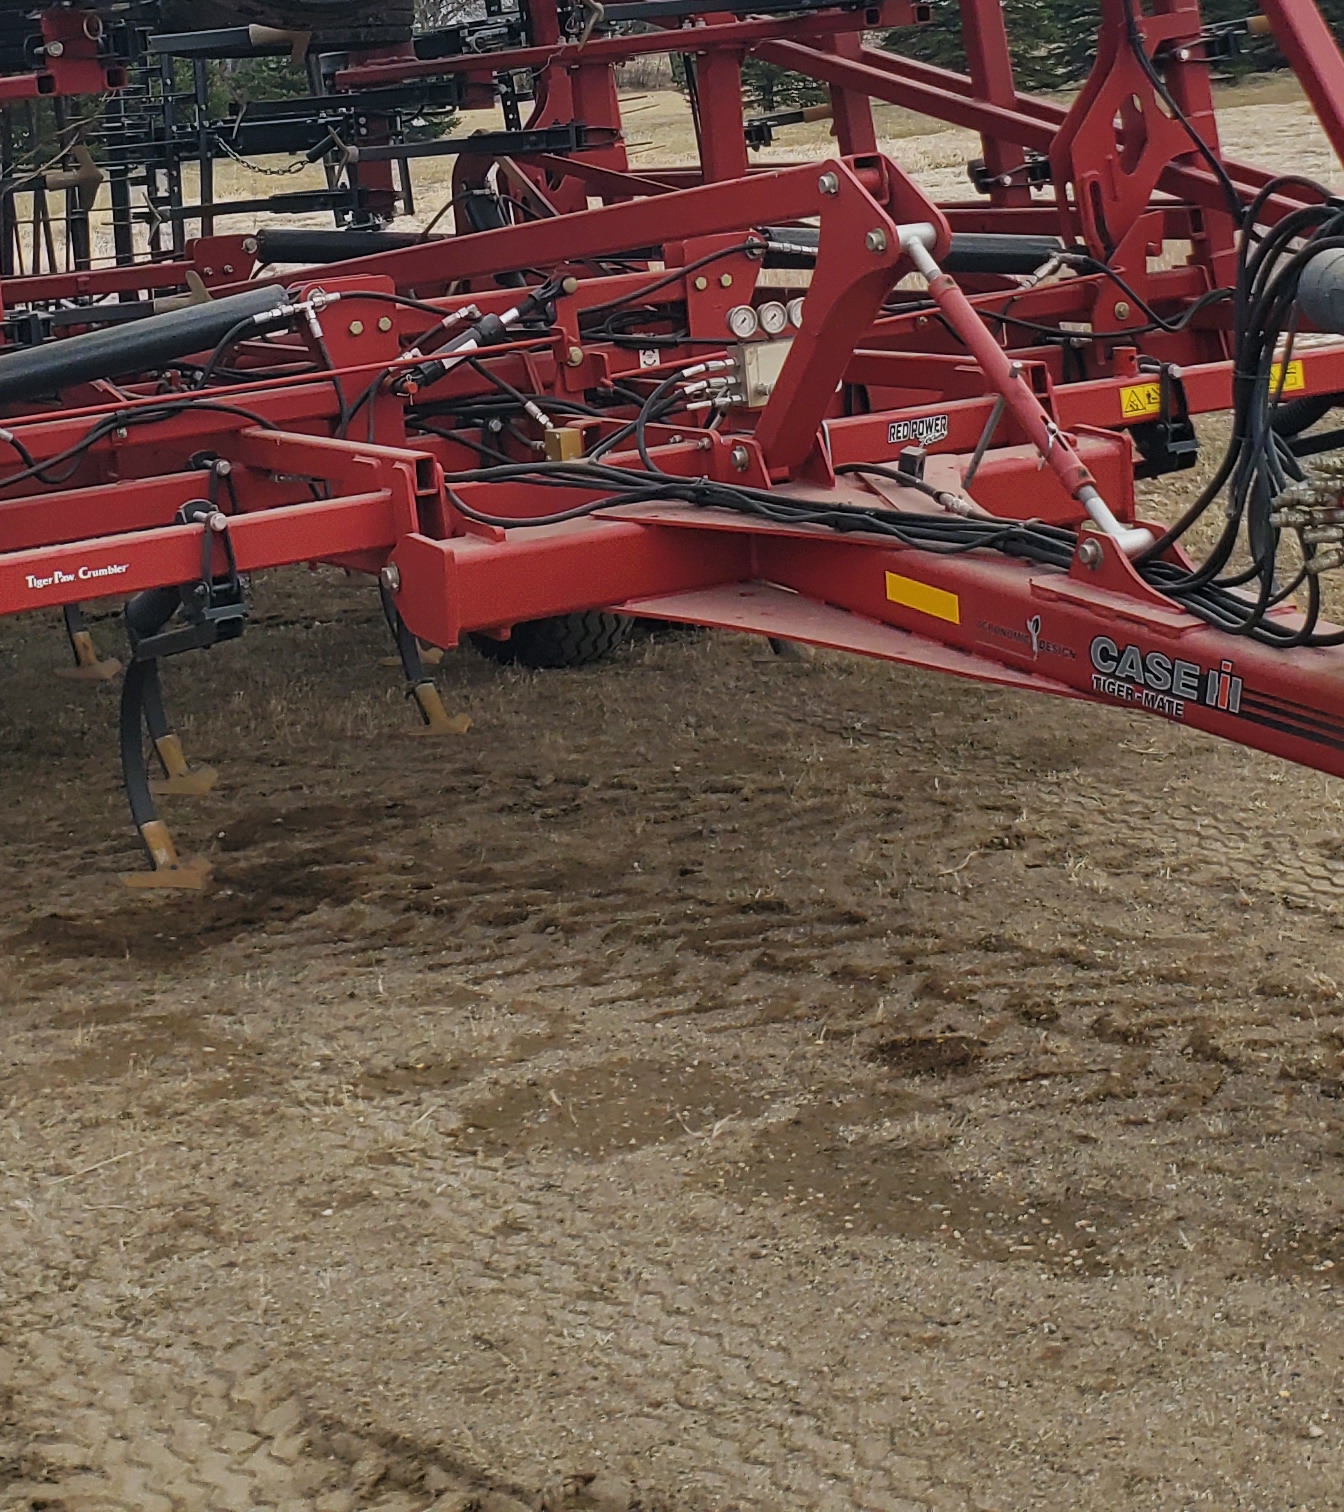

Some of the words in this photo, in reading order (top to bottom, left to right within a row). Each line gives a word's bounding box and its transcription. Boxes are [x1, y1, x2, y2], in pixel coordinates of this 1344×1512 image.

[888, 422, 910, 442] RED
[911, 415, 948, 438] POWER
[25, 575, 53, 589] Tiger
[78, 564, 128, 579] Crumbler
[1039, 639, 1076, 659] DESIGN
[1090, 636, 1201, 701] CASE
